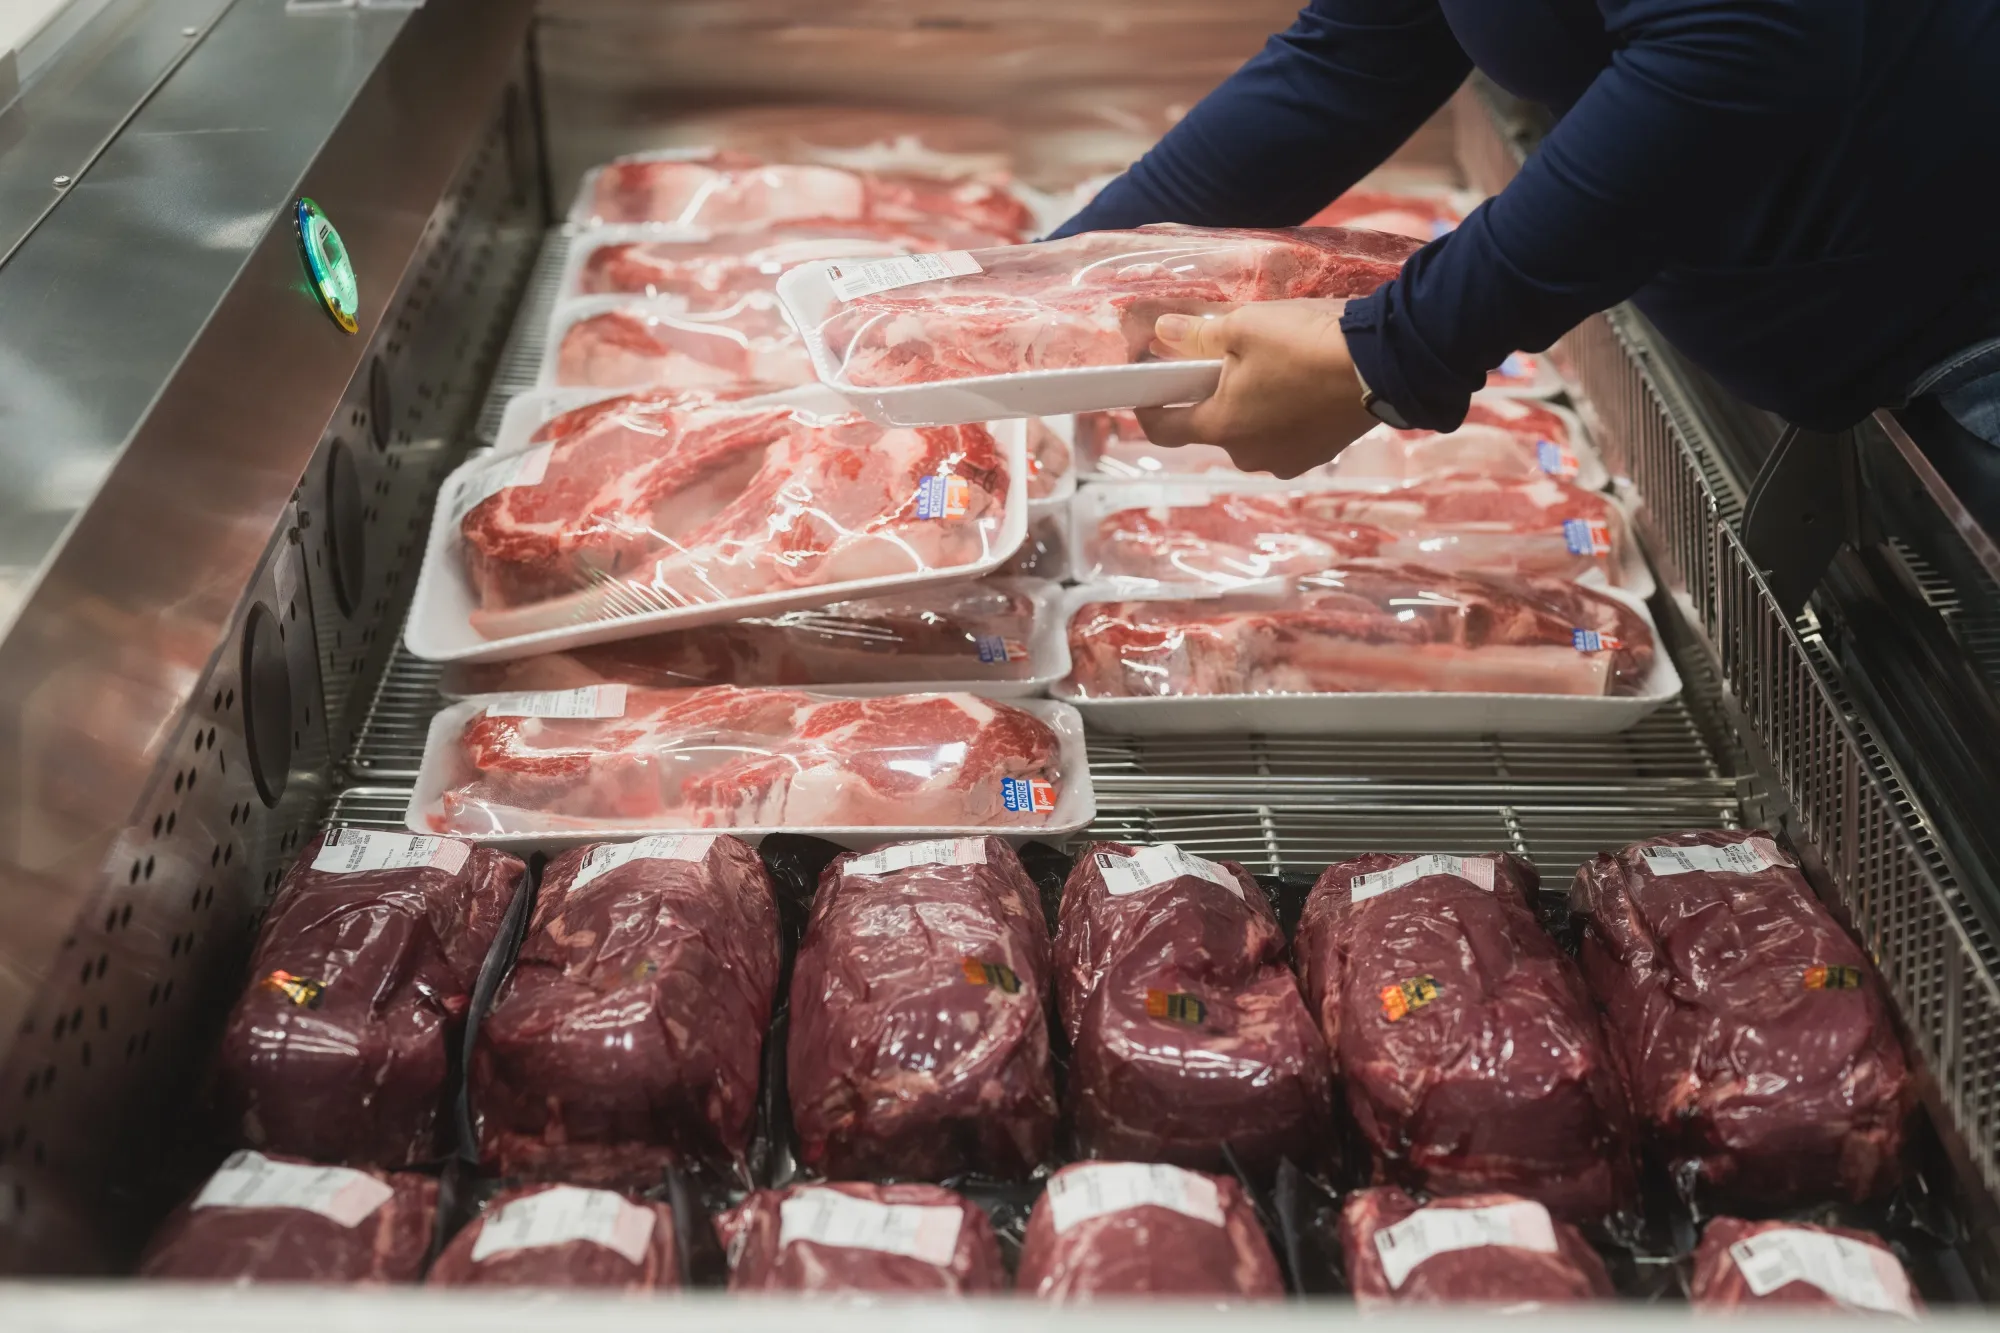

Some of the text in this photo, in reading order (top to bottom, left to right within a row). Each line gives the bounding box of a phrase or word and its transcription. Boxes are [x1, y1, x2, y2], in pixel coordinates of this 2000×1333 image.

[931, 479, 942, 513] CHOICE
[1004, 781, 1016, 808] U.S.D.A.
[1016, 781, 1029, 808] CHOICE
